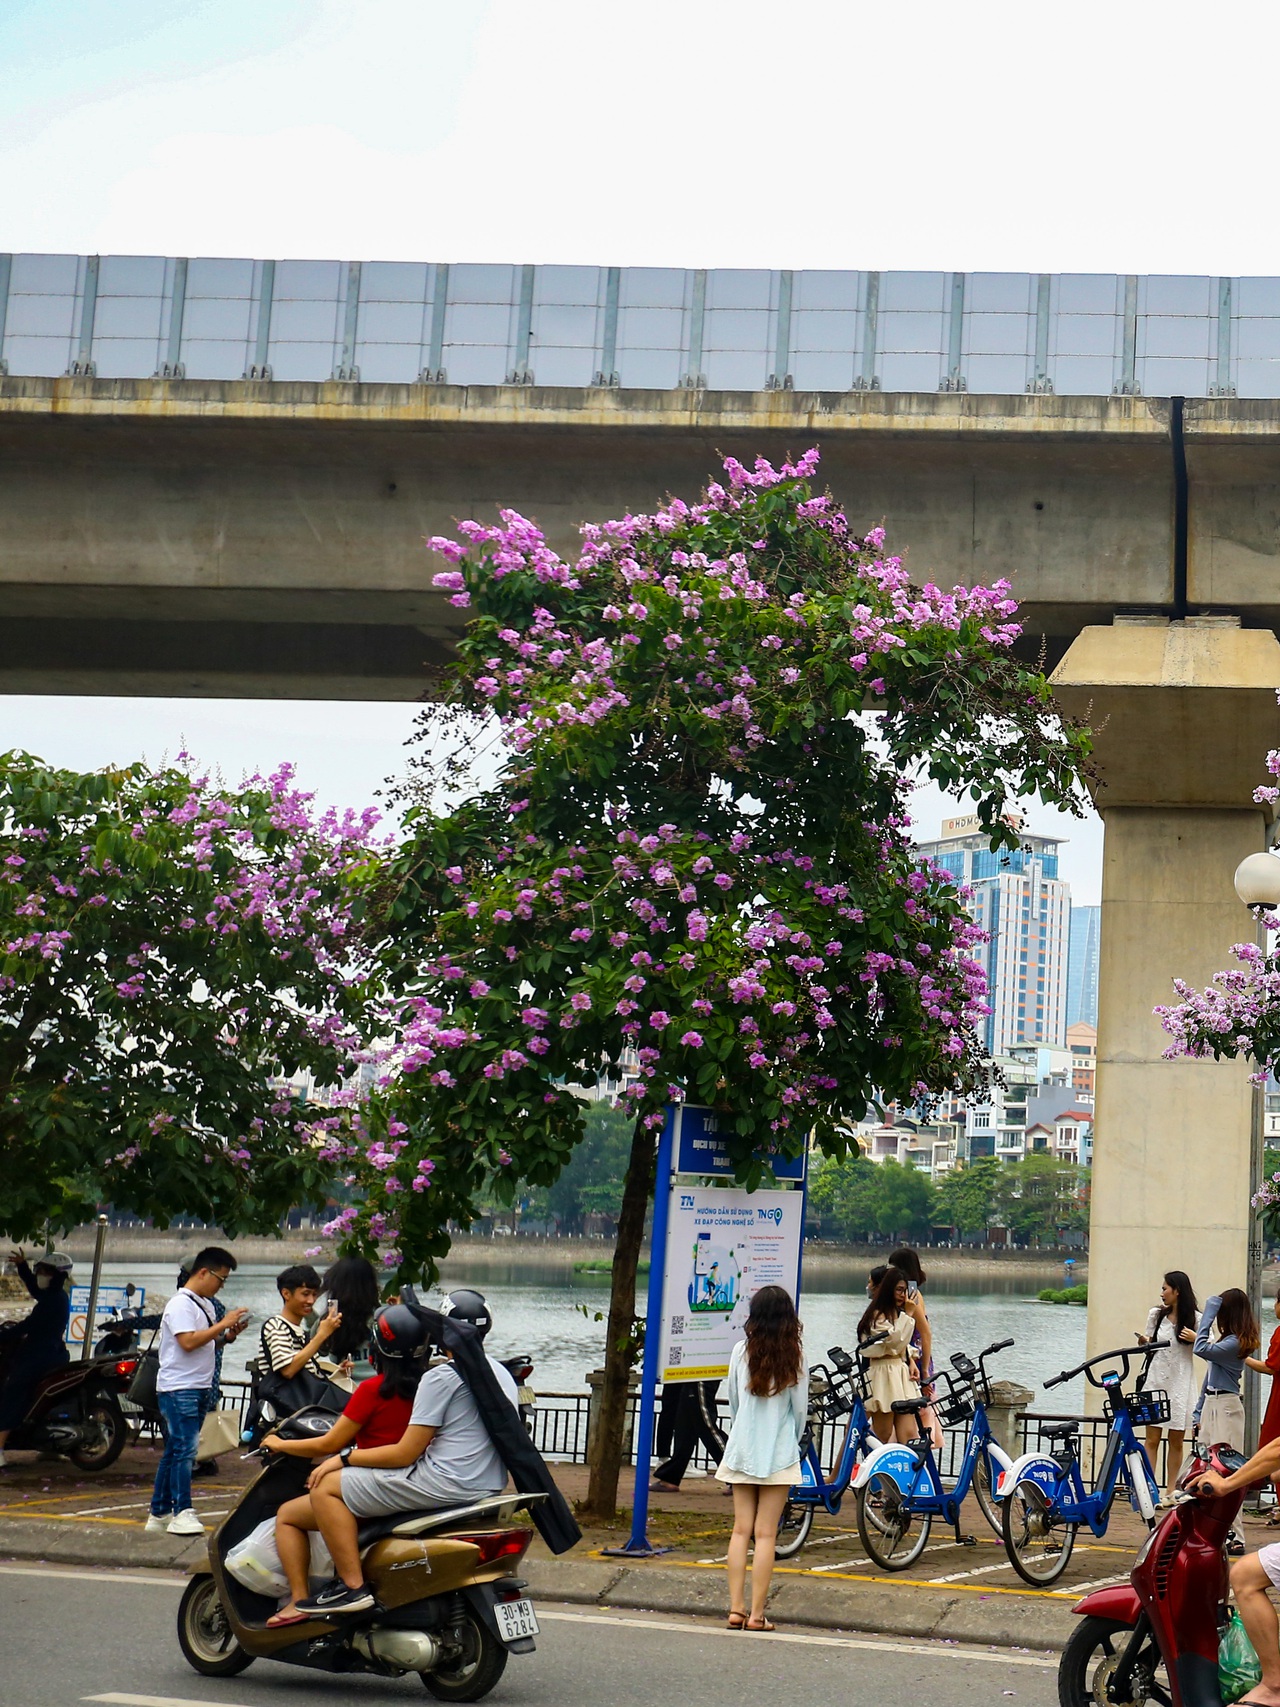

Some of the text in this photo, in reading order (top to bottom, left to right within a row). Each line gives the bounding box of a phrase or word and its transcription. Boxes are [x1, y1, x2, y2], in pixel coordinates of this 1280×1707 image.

[680, 1195, 695, 1207] TN
[714, 1217, 731, 1226] CÔNG
[505, 1618, 535, 1637] 6284
